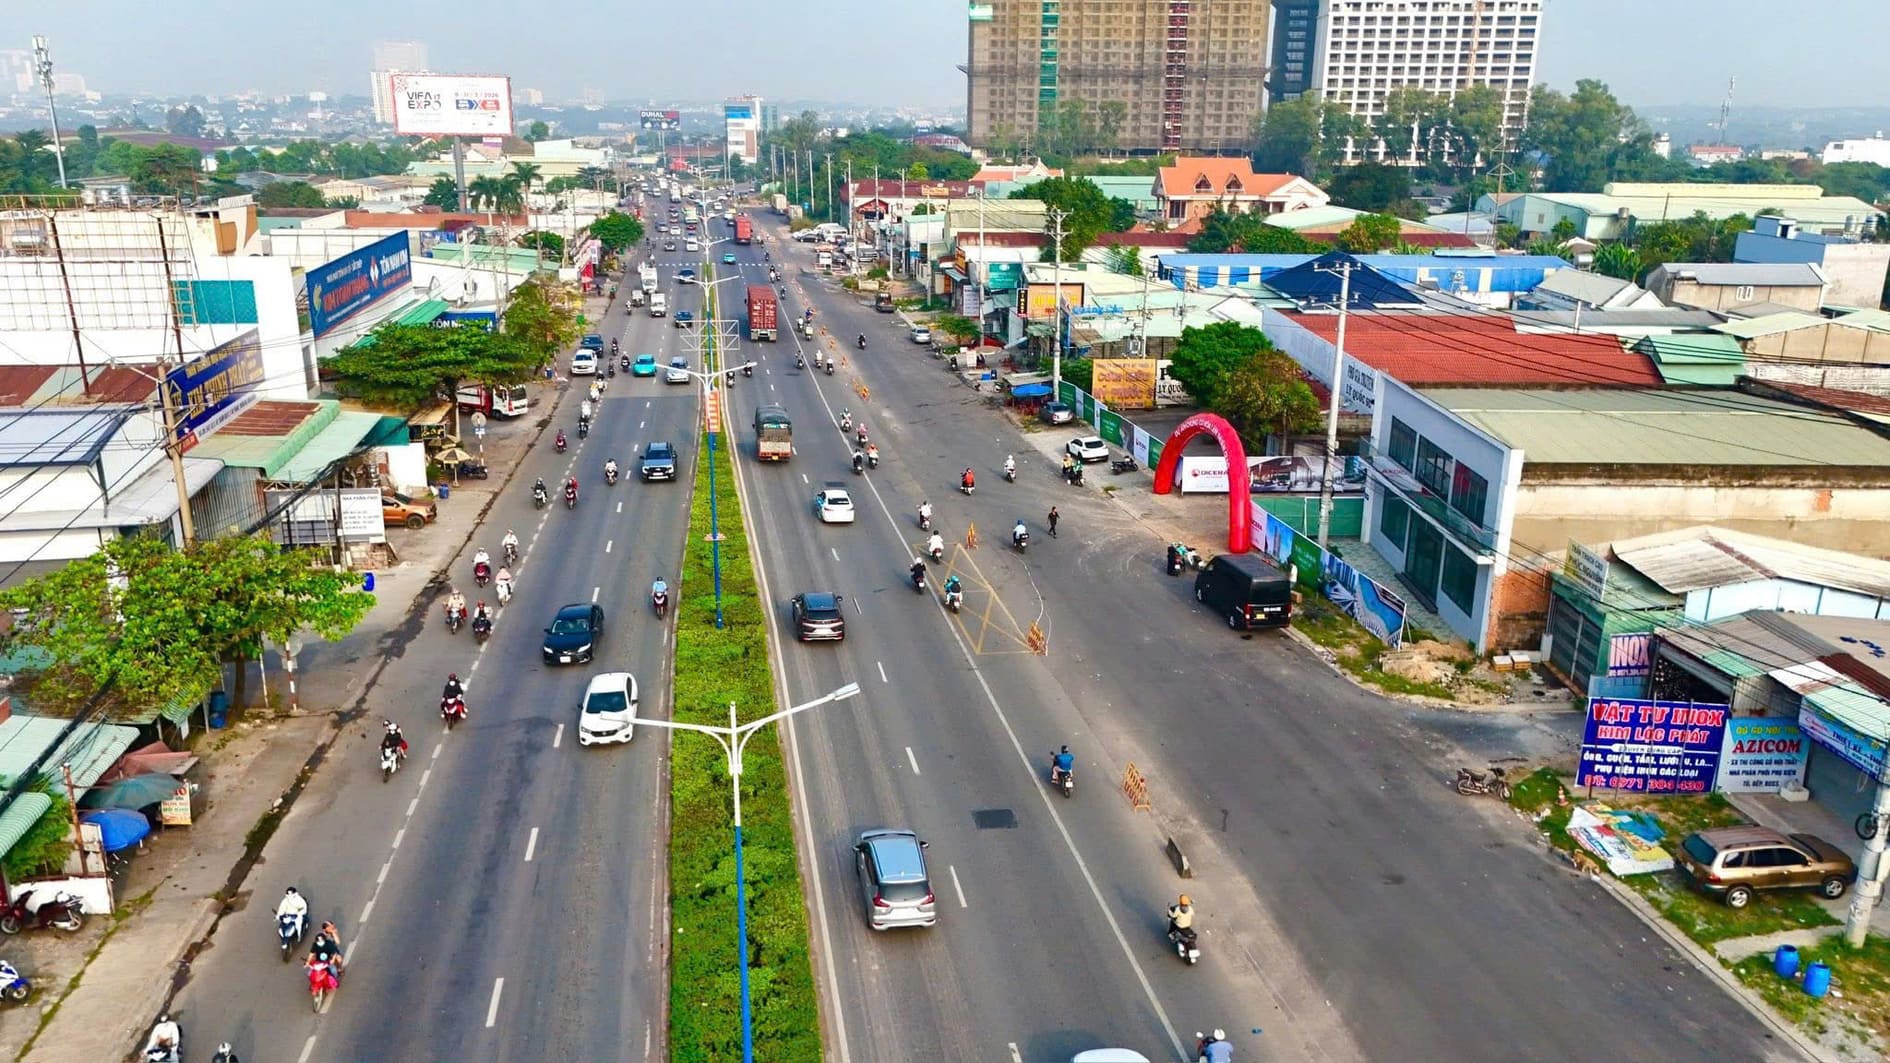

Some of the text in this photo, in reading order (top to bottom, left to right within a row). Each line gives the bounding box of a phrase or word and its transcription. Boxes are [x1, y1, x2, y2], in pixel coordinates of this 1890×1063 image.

[408, 100, 442, 110] EXPO
[1610, 636, 1650, 666] INOX
[1593, 701, 1634, 725] VẬT
[1671, 708, 1725, 726] INOX
[1597, 725, 1710, 744] KIM LỘC PHÁT
[1732, 739, 1800, 753] AZICOM
